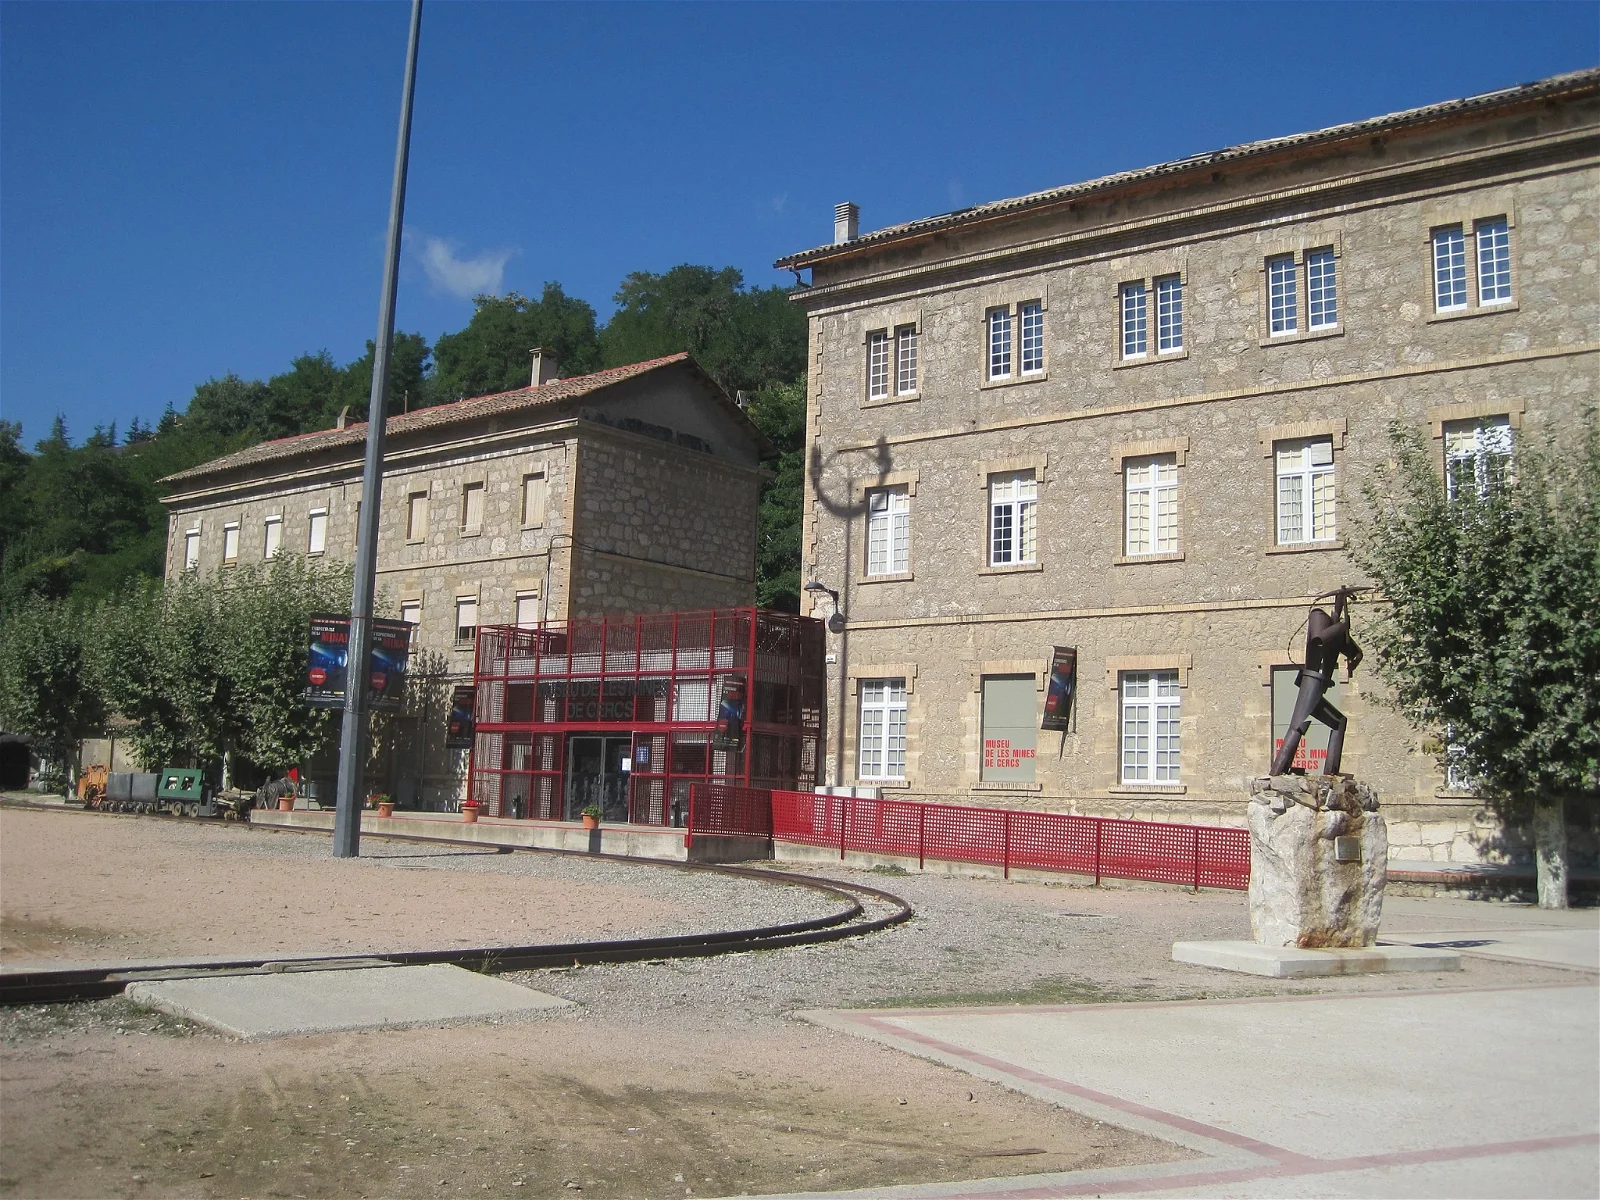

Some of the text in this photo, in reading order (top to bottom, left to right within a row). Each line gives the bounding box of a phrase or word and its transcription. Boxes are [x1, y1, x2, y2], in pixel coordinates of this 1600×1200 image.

[582, 681, 599, 697] DE
[602, 680, 627, 696] LES
[568, 701, 633, 718] DE CERCS
[986, 740, 1010, 748] MUSEU
[986, 750, 1035, 758] DE LES MINES
[1310, 749, 1328, 758] MIN
[985, 759, 1020, 767] DE CERCS
